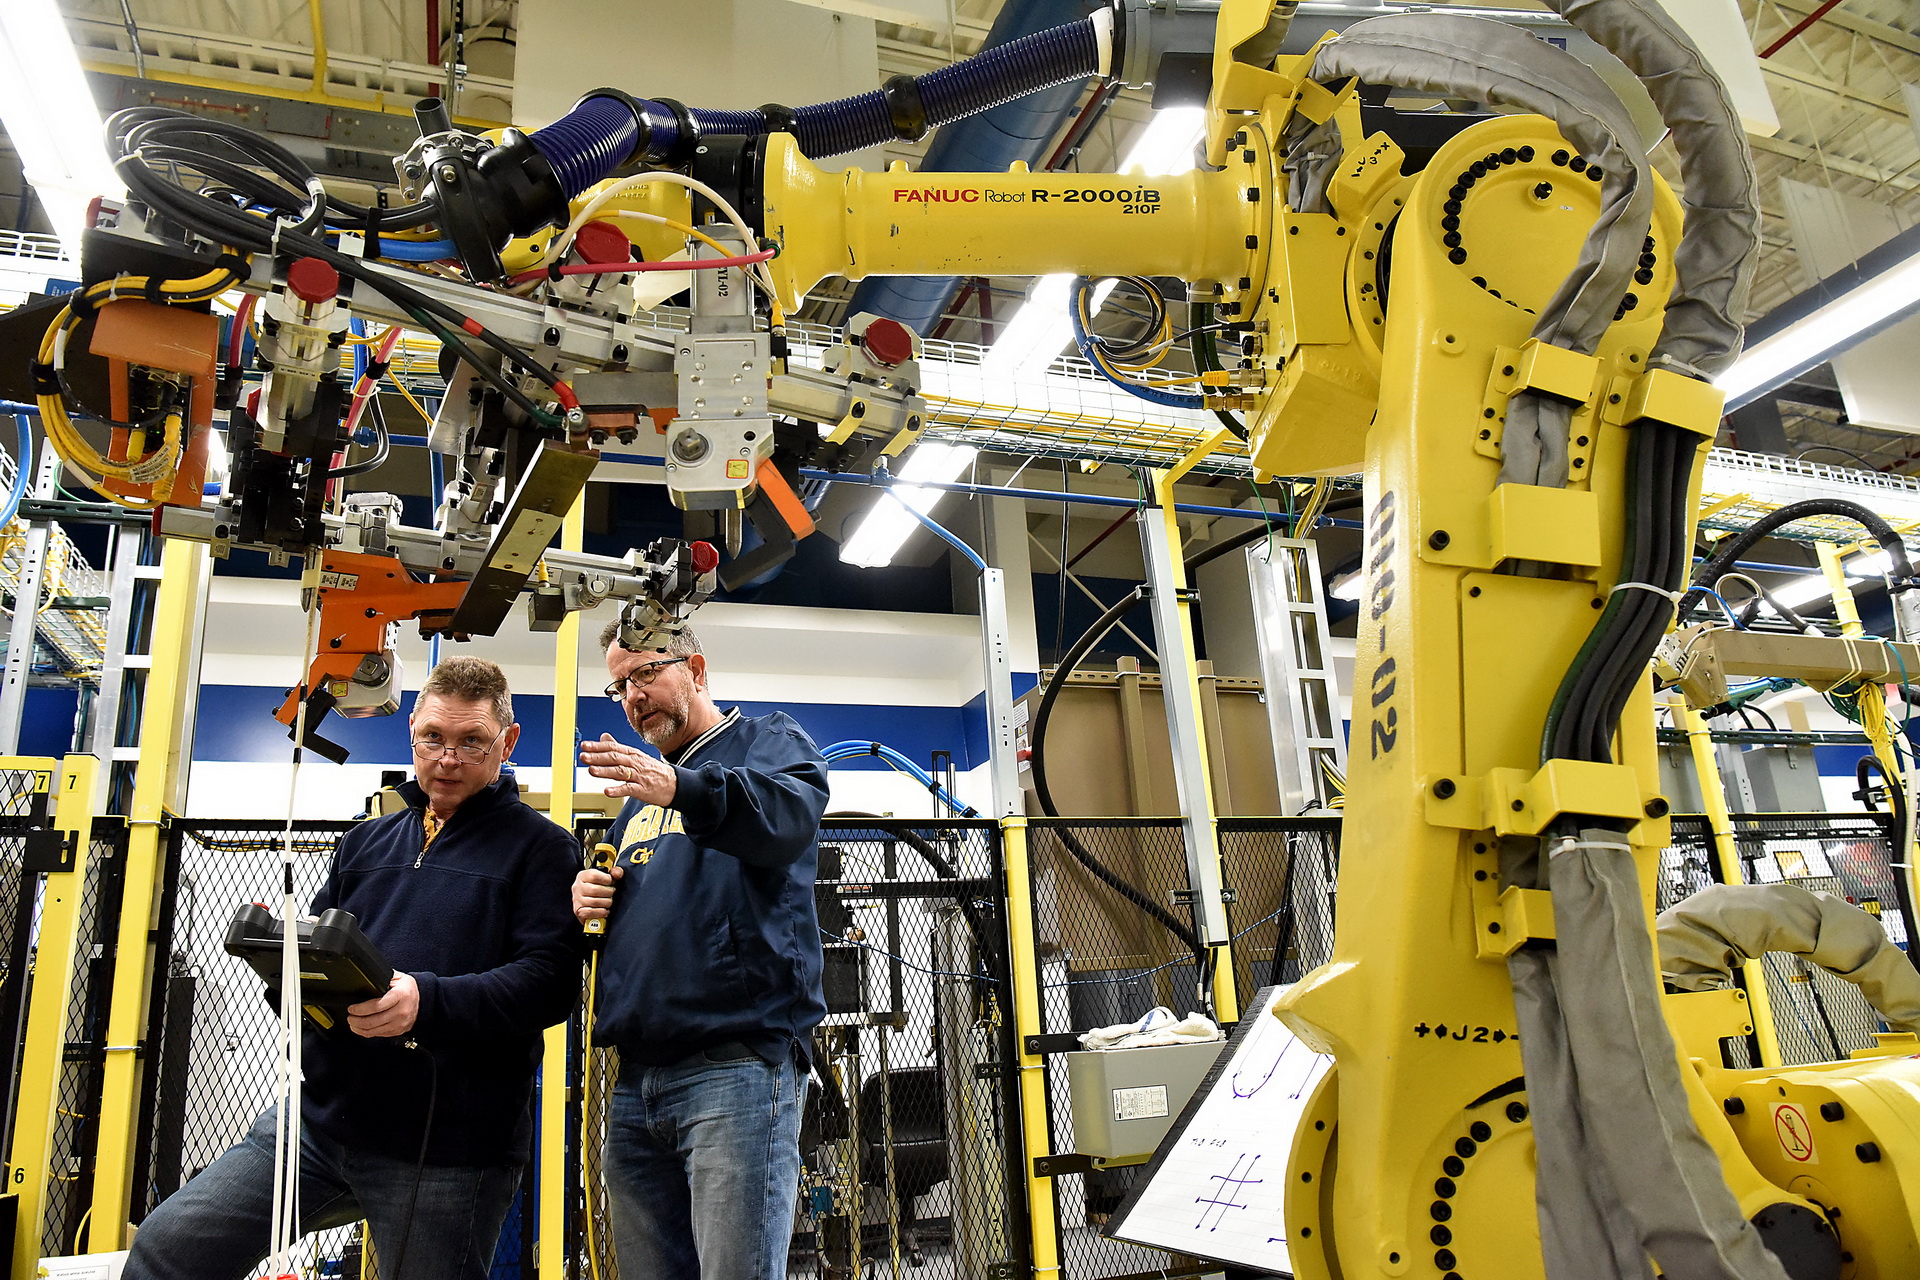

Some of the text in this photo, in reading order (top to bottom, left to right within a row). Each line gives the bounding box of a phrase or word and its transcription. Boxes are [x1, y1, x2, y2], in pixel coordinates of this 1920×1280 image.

[894, 189, 979, 203] FANUC
[984, 189, 1026, 203] Robot
[1122, 204, 1161, 215] 210F
[717, 266, 729, 297] YL-02
[38, 775, 46, 790] 7
[68, 774, 77, 790] 7
[14, 1167, 25, 1184] 6
